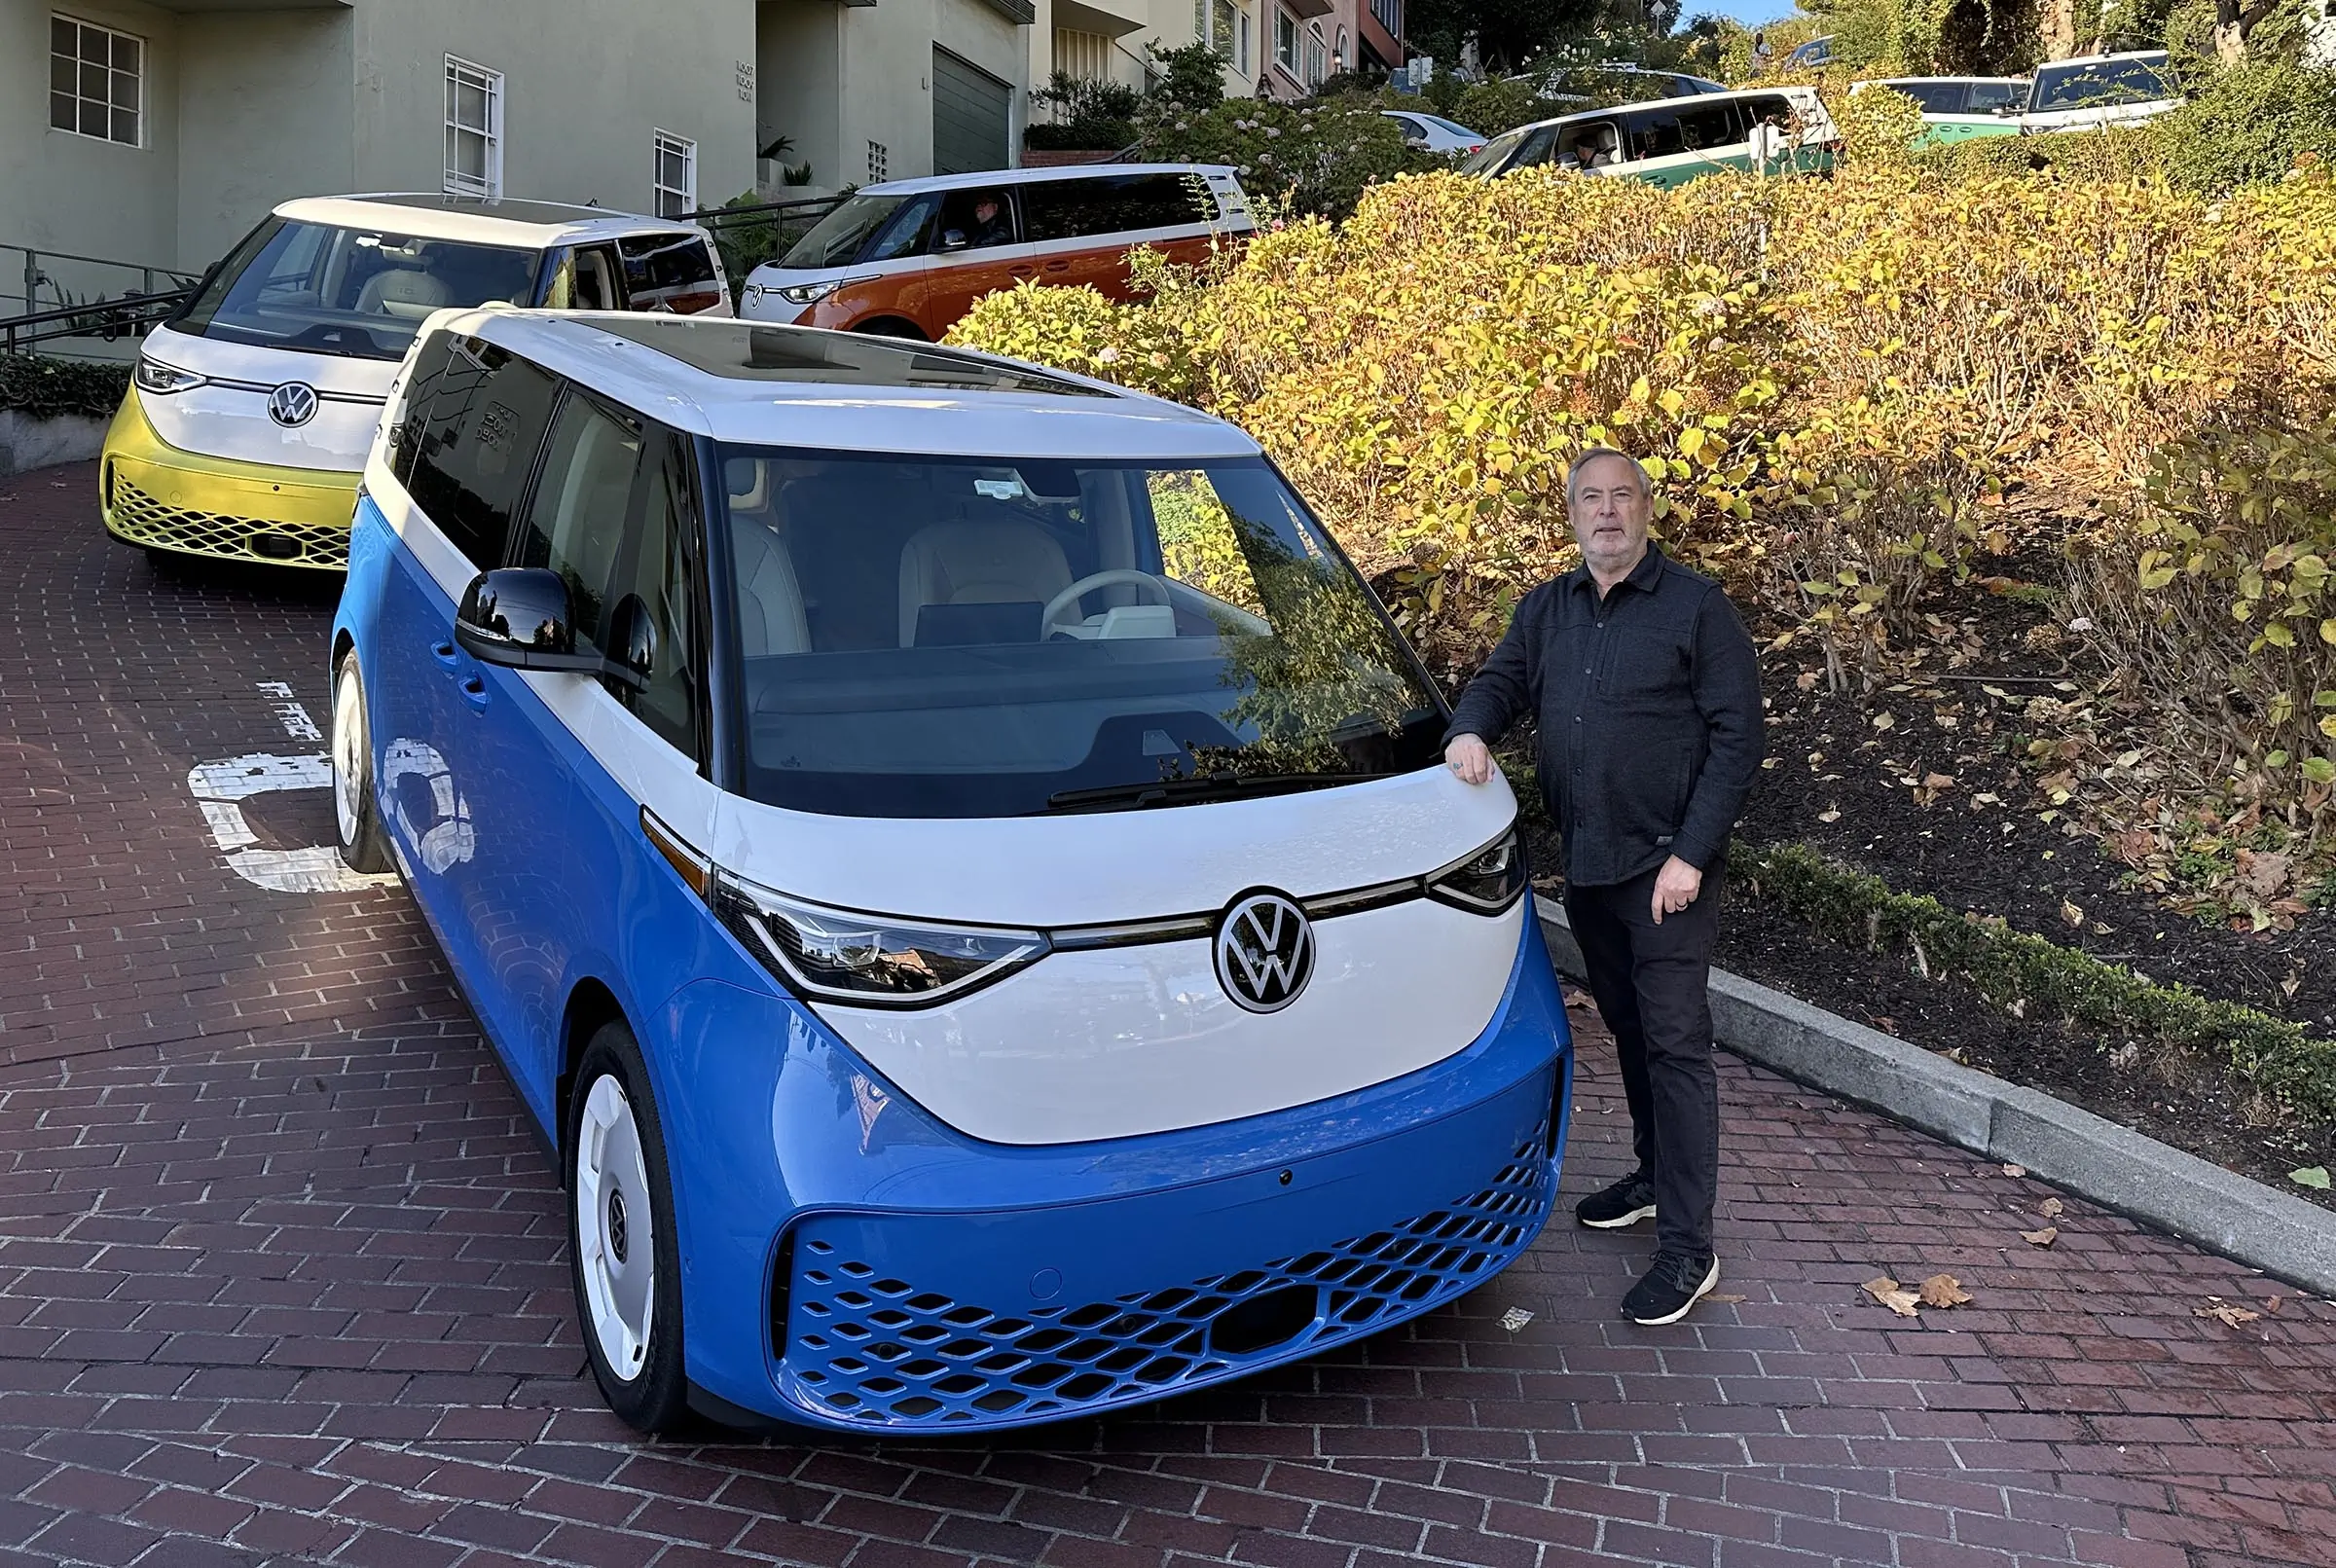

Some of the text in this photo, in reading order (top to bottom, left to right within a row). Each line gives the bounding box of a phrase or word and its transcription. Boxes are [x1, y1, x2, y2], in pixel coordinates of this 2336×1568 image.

[736, 60, 754, 75] 1007
[272, 384, 315, 424] VW
[1223, 897, 1311, 1006] VW
